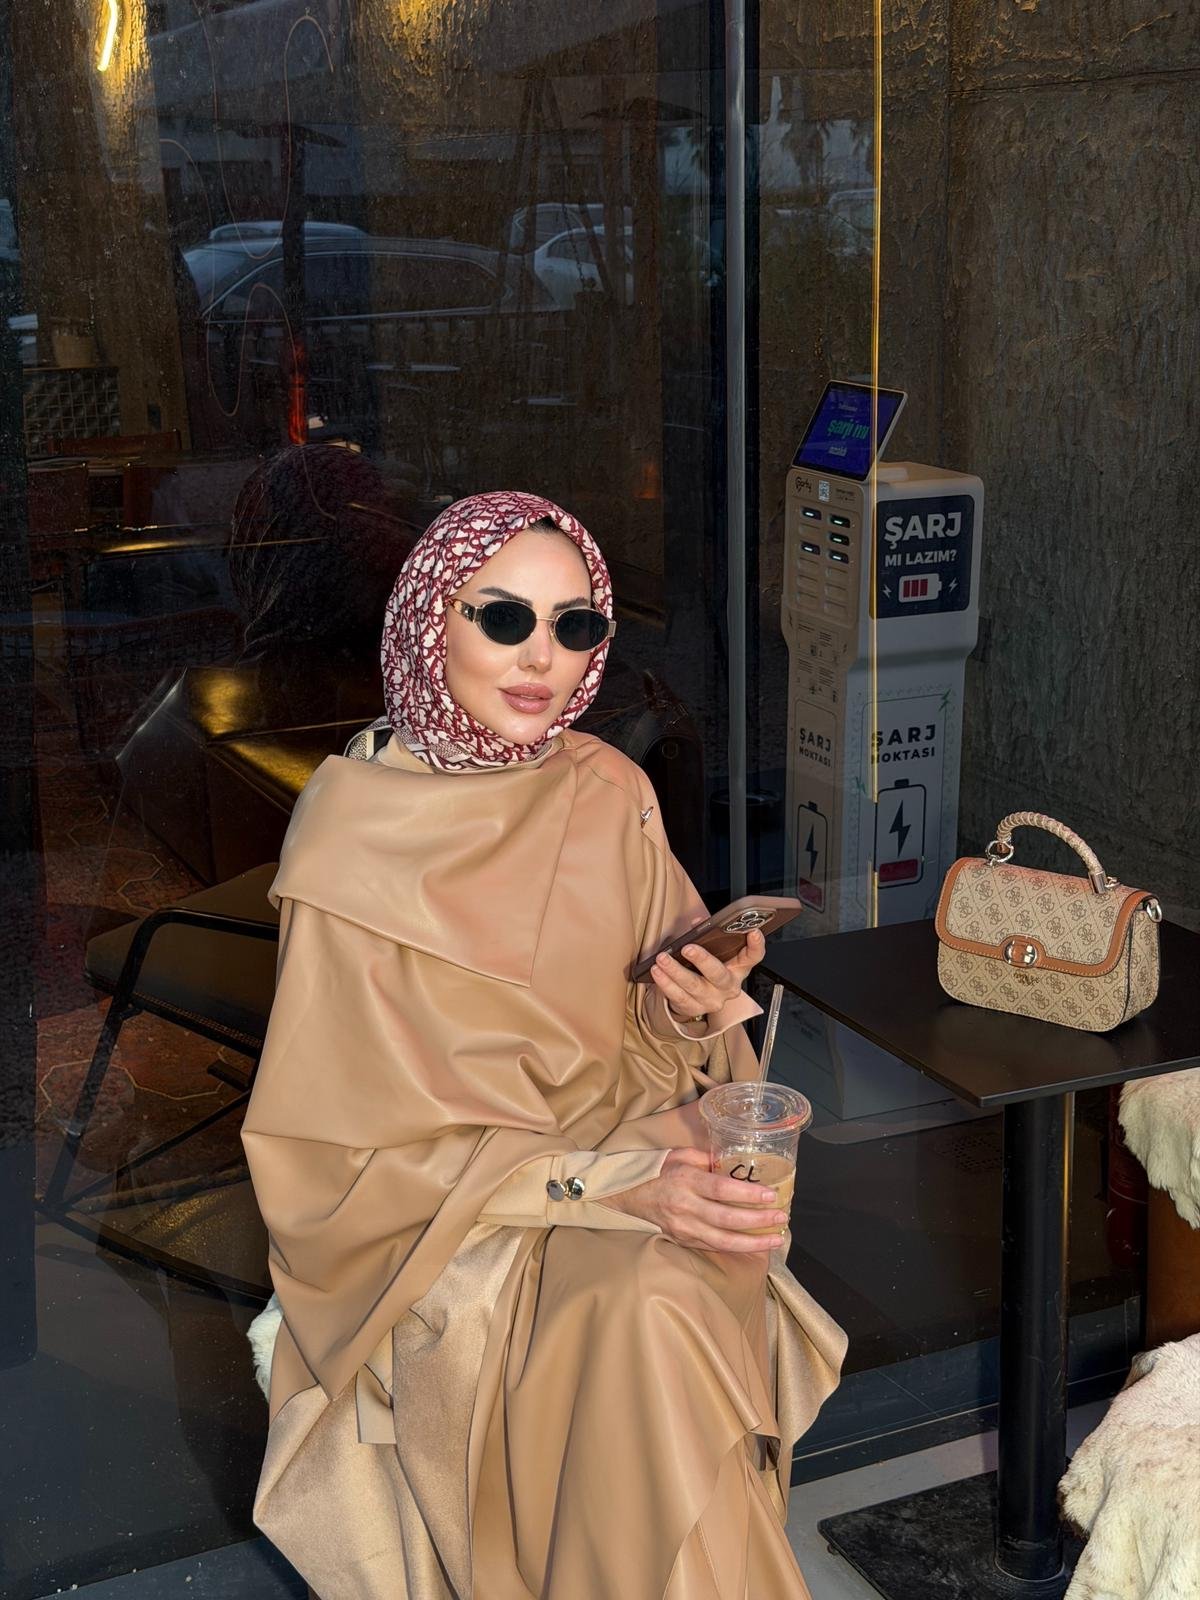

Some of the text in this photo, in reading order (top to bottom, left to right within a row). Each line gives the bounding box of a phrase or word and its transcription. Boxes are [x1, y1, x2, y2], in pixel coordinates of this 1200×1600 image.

[884, 512, 962, 549] ŞARJ
[885, 549, 957, 567] MI LAZIM?
[799, 727, 832, 753] ŞARJ
[871, 724, 936, 752] ŞARJ
